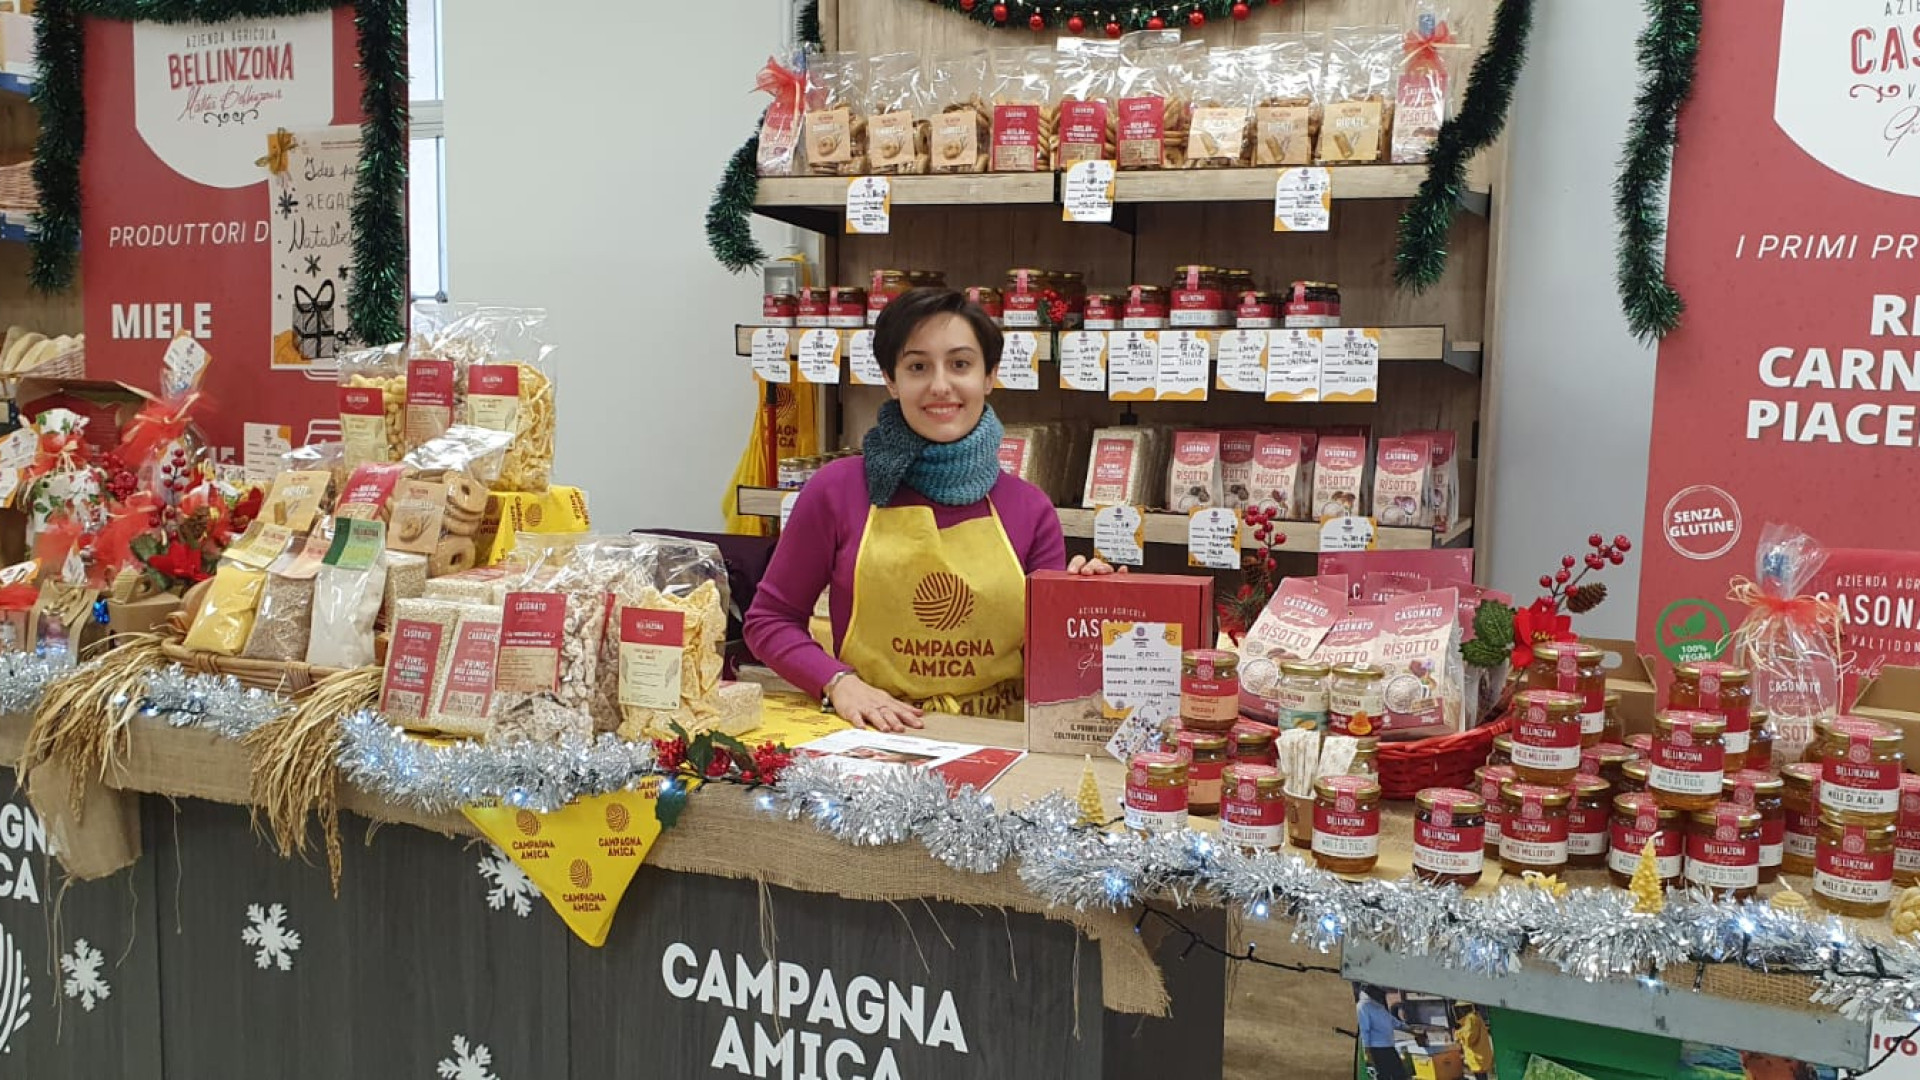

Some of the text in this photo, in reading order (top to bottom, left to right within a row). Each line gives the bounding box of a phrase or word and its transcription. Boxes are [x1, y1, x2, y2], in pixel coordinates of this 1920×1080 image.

[186, 27, 277, 48] AZIENDA AGRICOLA
[168, 42, 294, 90] BELLINZONA
[110, 221, 245, 248] PRODUTTORI
[1735, 234, 1746, 259] I
[1757, 234, 1858, 260] PRIMI
[111, 302, 213, 340] MIELE
[1746, 399, 1920, 448] PIACE
[1262, 446, 1292, 457] CASONATO
[1324, 448, 1358, 459] CASONATO
[1385, 451, 1419, 462] CASONATO
[1176, 470, 1209, 482] RISOTTO
[1256, 473, 1290, 486] RISOTTO
[1319, 474, 1356, 487] RISOTTO
[1379, 479, 1418, 492] RISOTTO
[1674, 507, 1722, 524] SENZA
[1669, 520, 1735, 538] GLUTINE
[1836, 574, 1887, 590] AZIENDA
[1283, 596, 1329, 617] CASONATO
[1393, 606, 1443, 621] CASONATO
[1332, 621, 1374, 632] ASONATO
[1257, 623, 1311, 648] RISOTTO
[891, 637, 995, 658] CAMPAGNA
[1382, 638, 1439, 657] RISOTTO
[909, 658, 976, 678] AMICA
[1519, 725, 1557, 739] BELLINZONA
[1662, 747, 1703, 763] BELLINZONA
[1835, 765, 1881, 780] BELLINZONA
[1856, 794, 1885, 805] ACACIA
[1326, 814, 1366, 828] BELLINZONA
[1511, 819, 1552, 833] BELLINZONA
[598, 836, 643, 848] CAMPAGNA
[1421, 827, 1460, 842] BELLINZONA
[511, 838, 555, 850] CAMPAGNA
[1704, 843, 1746, 857] BELLINZONA
[520, 849, 550, 860] AMICA
[607, 847, 636, 857] AMICA
[1830, 855, 1874, 871] BELLINZONA
[562, 893, 607, 903] CAMPAGNA
[1850, 884, 1879, 897] ACACIA
[572, 902, 601, 912] AMICA
[661, 942, 970, 1055] CAMPAGNA
[711, 1015, 914, 1080] AMICA
